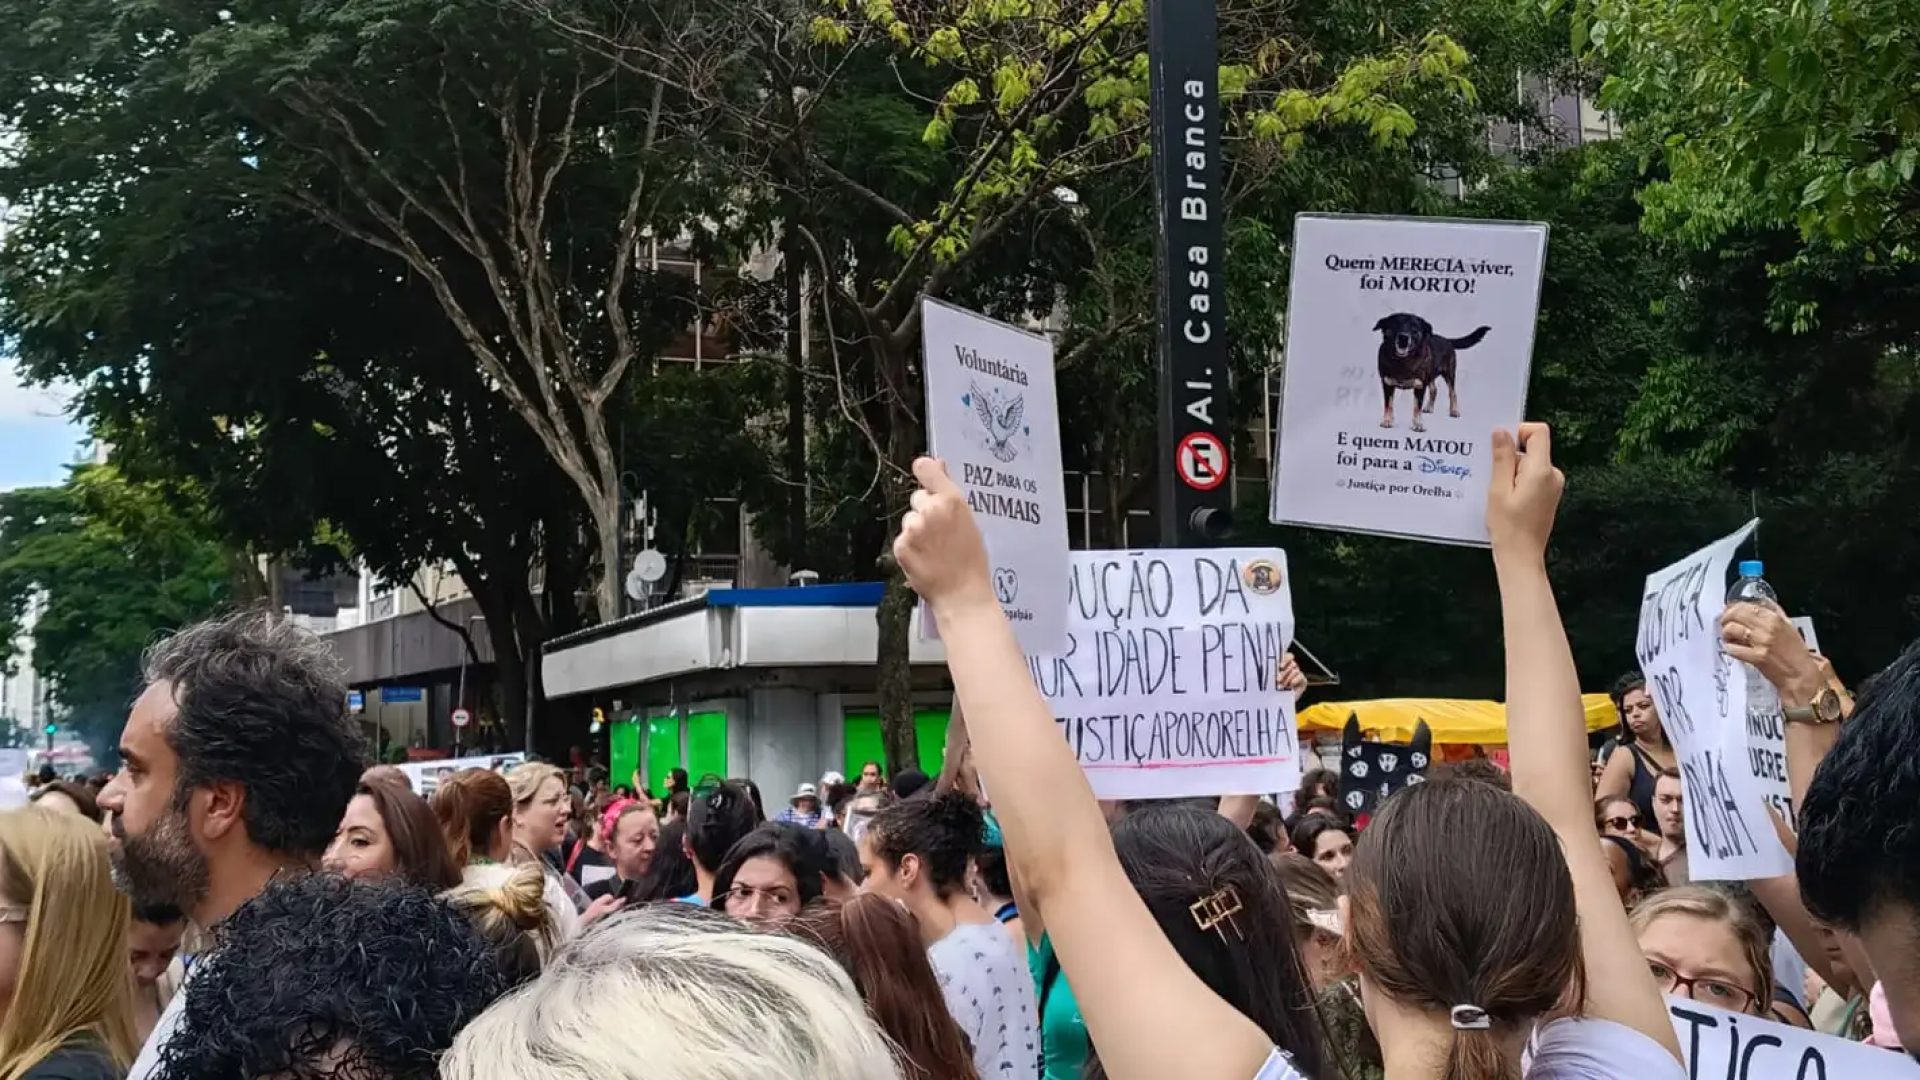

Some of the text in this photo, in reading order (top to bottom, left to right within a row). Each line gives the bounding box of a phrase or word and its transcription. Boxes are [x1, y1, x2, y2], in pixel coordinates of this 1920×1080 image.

[1180, 79, 1214, 425] Al. Casa Branca
[1325, 253, 1514, 277] Quem MERECIA viver,
[1360, 273, 1476, 294] foi MORTO!
[954, 344, 1029, 386] Voluntária
[1336, 450, 1358, 466] foi
[1362, 456, 1398, 471] para
[1403, 459, 1412, 471] a
[1337, 431, 1473, 456] E quem MATOU
[963, 462, 1038, 494] PAZ PARA OS
[1346, 478, 1452, 498] Justiça por Orelha
[967, 489, 1041, 526] ANIMAIS
[1069, 551, 1250, 631] UÇÃO DA
[1095, 626, 1188, 698] IDADE
[1202, 621, 1293, 694] PENAL
[1055, 707, 1293, 768] USTIÇAPORORELHA
